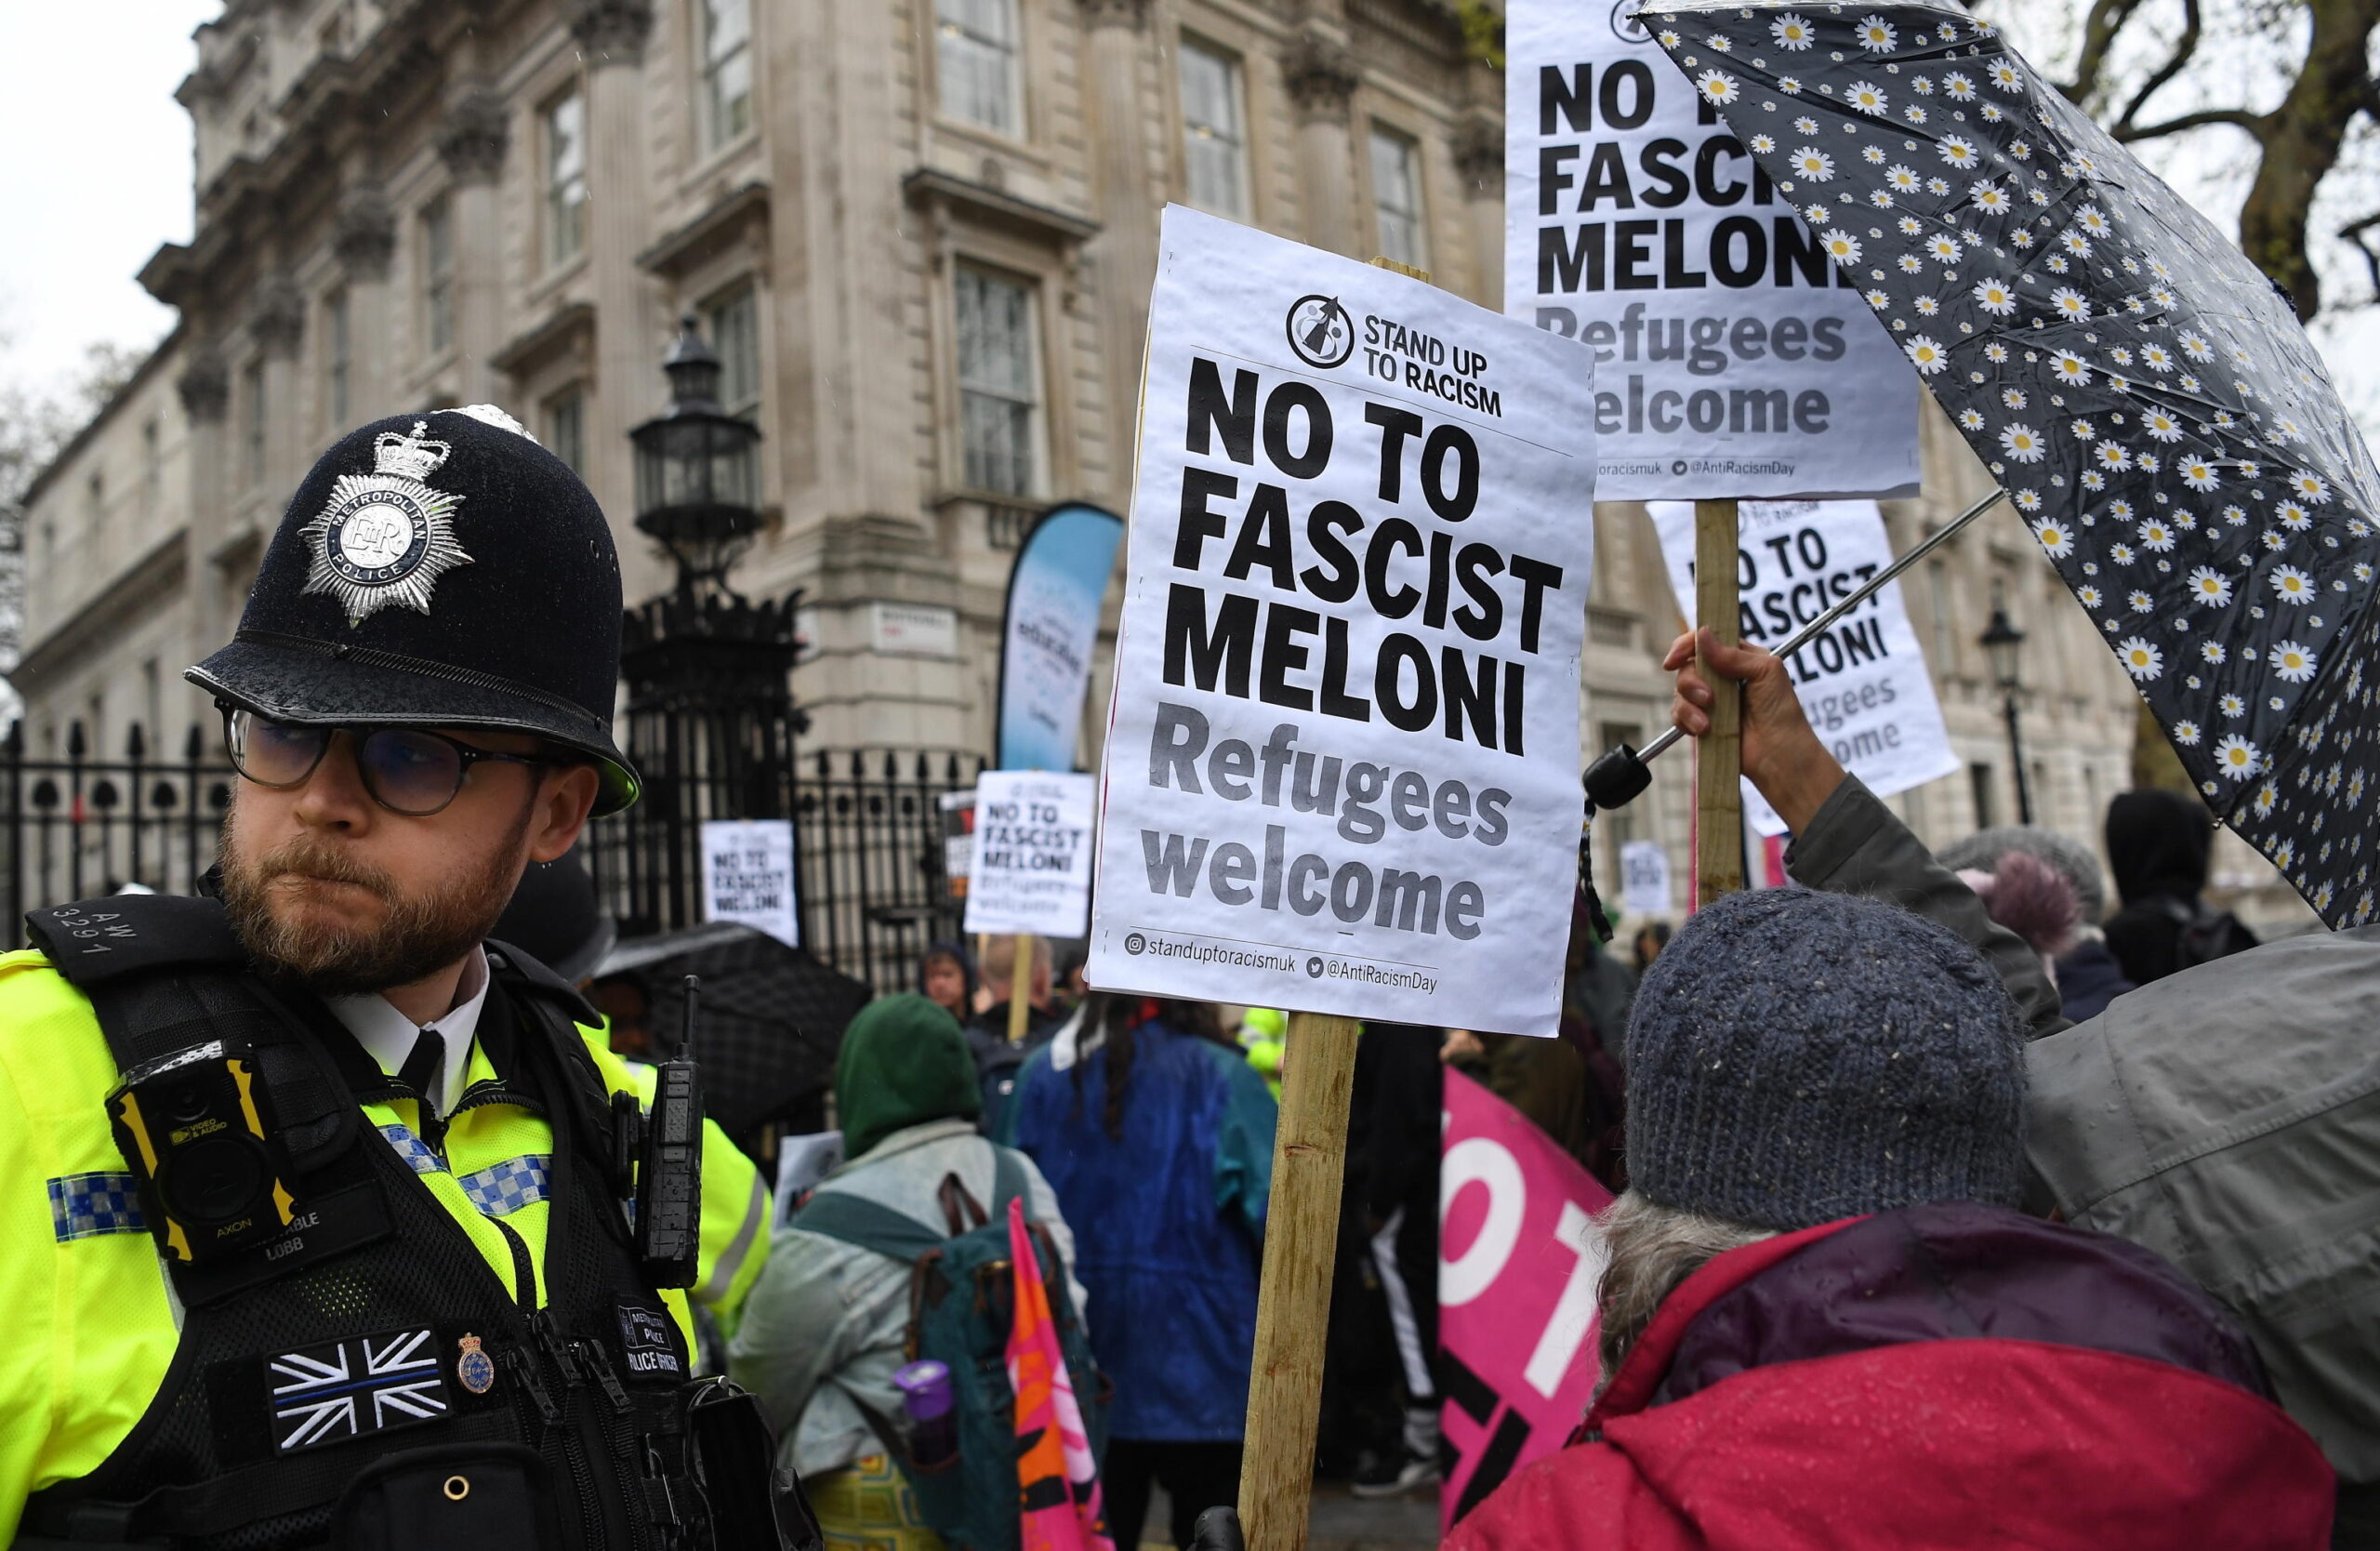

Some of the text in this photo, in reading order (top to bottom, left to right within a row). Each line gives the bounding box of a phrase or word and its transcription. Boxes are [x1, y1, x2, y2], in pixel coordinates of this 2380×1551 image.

[1540, 60, 1655, 136] NO
[1539, 134, 1774, 216] FASC
[1538, 216, 1859, 295] MELON
[1365, 314, 1488, 379] STAND UP
[1363, 347, 1501, 418] TO RACISM
[1595, 375, 1831, 434] elcome
[1185, 356, 1480, 522] NO TO
[1598, 461, 1795, 477] oracismuk @AntiRacismDay
[332, 492, 427, 539] METROPOLITAN
[333, 553, 403, 580] POLICE
[1172, 466, 1564, 655] FASCIST
[1765, 527, 1828, 578] TO
[1739, 563, 1878, 642] ASCIST
[1163, 583, 1525, 757] MELONI
[1785, 617, 1889, 687] LONI
[1807, 678, 1896, 730] ugees
[1149, 702, 1513, 846] Refugees
[985, 826, 1082, 849] FASCIST
[988, 803, 1059, 824] NO TO
[984, 852, 1072, 871] MELONI
[1141, 824, 1485, 940] welcome
[53, 908, 112, 953] 3291
[91, 913, 137, 937] AW
[1148, 938, 1438, 995] standuptoracismuk @AntiRacismDay
[190, 1118, 217, 1132] VIDEO
[201, 1121, 228, 1136] AUDIO
[217, 1217, 252, 1239] AXON
[265, 1237, 304, 1262] LOBB
